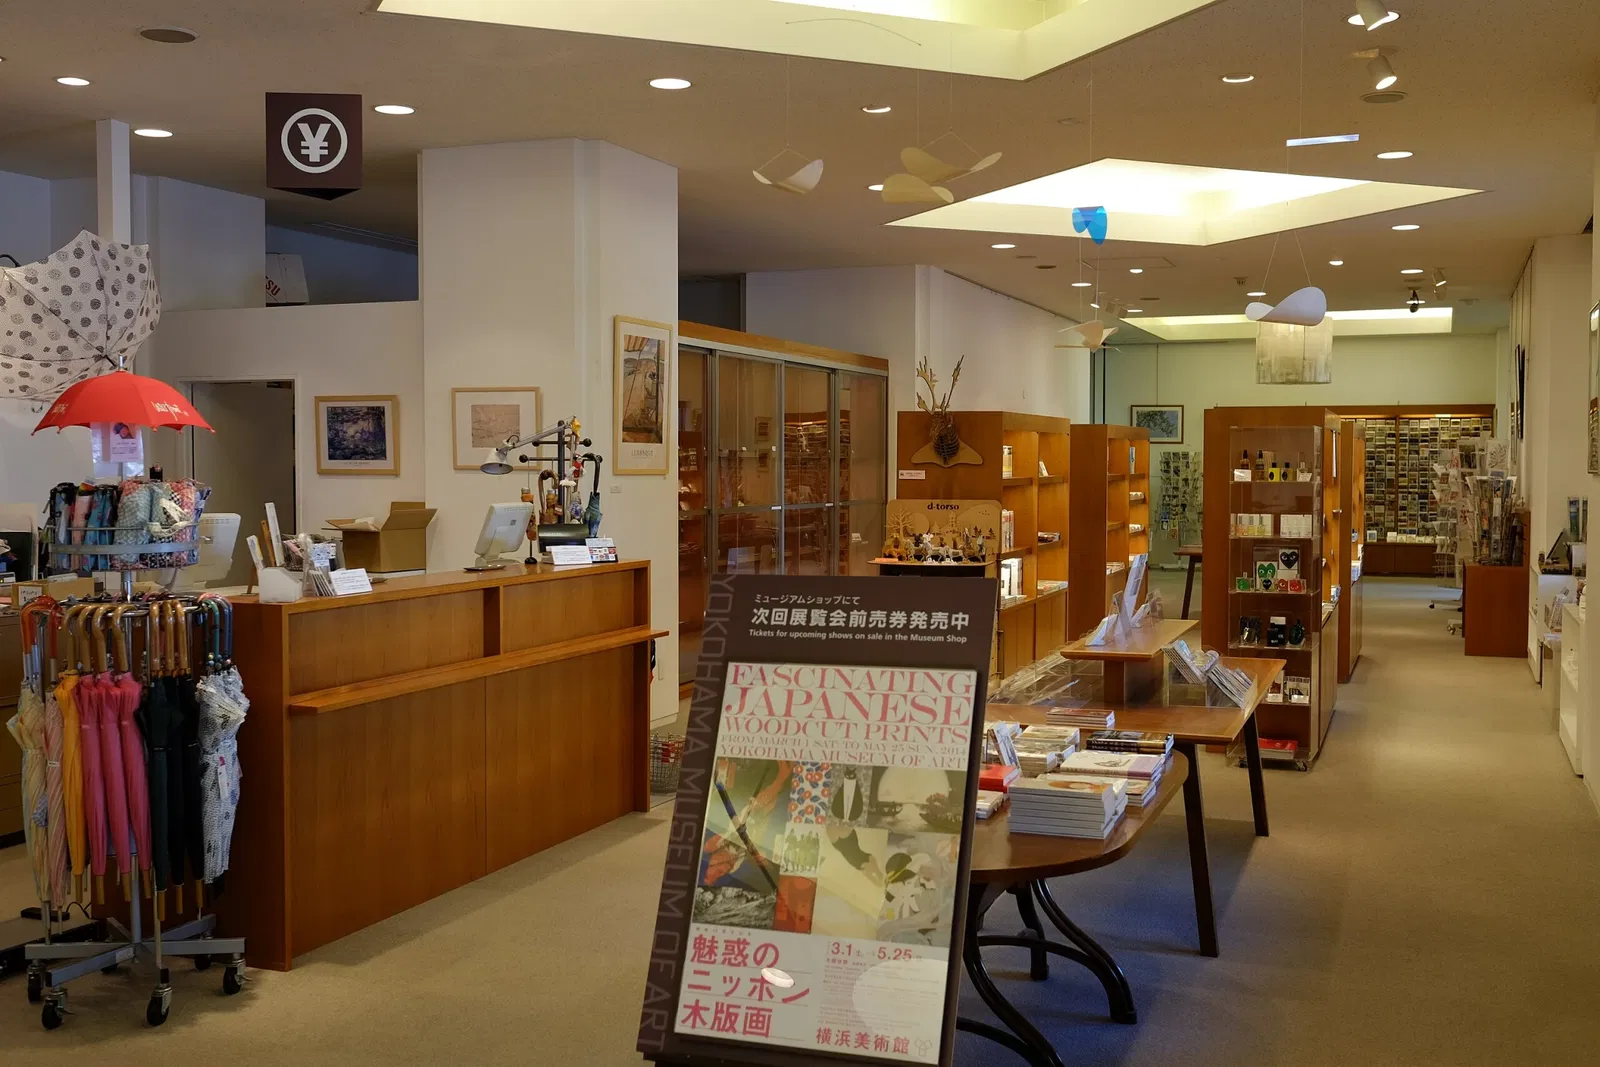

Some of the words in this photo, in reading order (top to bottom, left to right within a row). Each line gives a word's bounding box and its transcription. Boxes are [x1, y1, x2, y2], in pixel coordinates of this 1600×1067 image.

[265, 276, 281, 296] SU
[927, 502, 960, 511] d-torso
[754, 593, 861, 606] ミュージアムショップにて
[751, 607, 970, 631] 次回展覧会前売券発売中
[749, 629, 775, 637] Tickets
[776, 630, 788, 638] for
[789, 631, 827, 640] upcoming
[828, 631, 853, 640] shows
[867, 633, 883, 641] sale
[884, 633, 893, 641] in
[895, 633, 908, 641] the
[910, 634, 945, 642] Museum
[946, 634, 968, 644] Shop
[684, 574, 737, 755] YOKOHAMA
[728, 664, 973, 695] FASCINATING
[724, 686, 971, 726] JAPANESE
[721, 735, 754, 744] FROM
[724, 716, 858, 740] WOODCUT
[864, 723, 968, 745] PRINTS
[721, 744, 814, 760] YOKOHAMA
[820, 750, 896, 766] MUSEUM
[901, 754, 925, 767] OF
[928, 756, 966, 769] ART
[658, 768, 706, 918] MUSEUM
[651, 930, 681, 979] OF
[691, 934, 780, 968] 魅惑の
[831, 941, 853, 957] 3.1
[877, 946, 913, 961] 5.25
[687, 968, 811, 1004] ニッポン
[638, 981, 672, 1052] ART
[681, 1000, 774, 1039] 木版画
[816, 1026, 910, 1056] 横浜美術館
